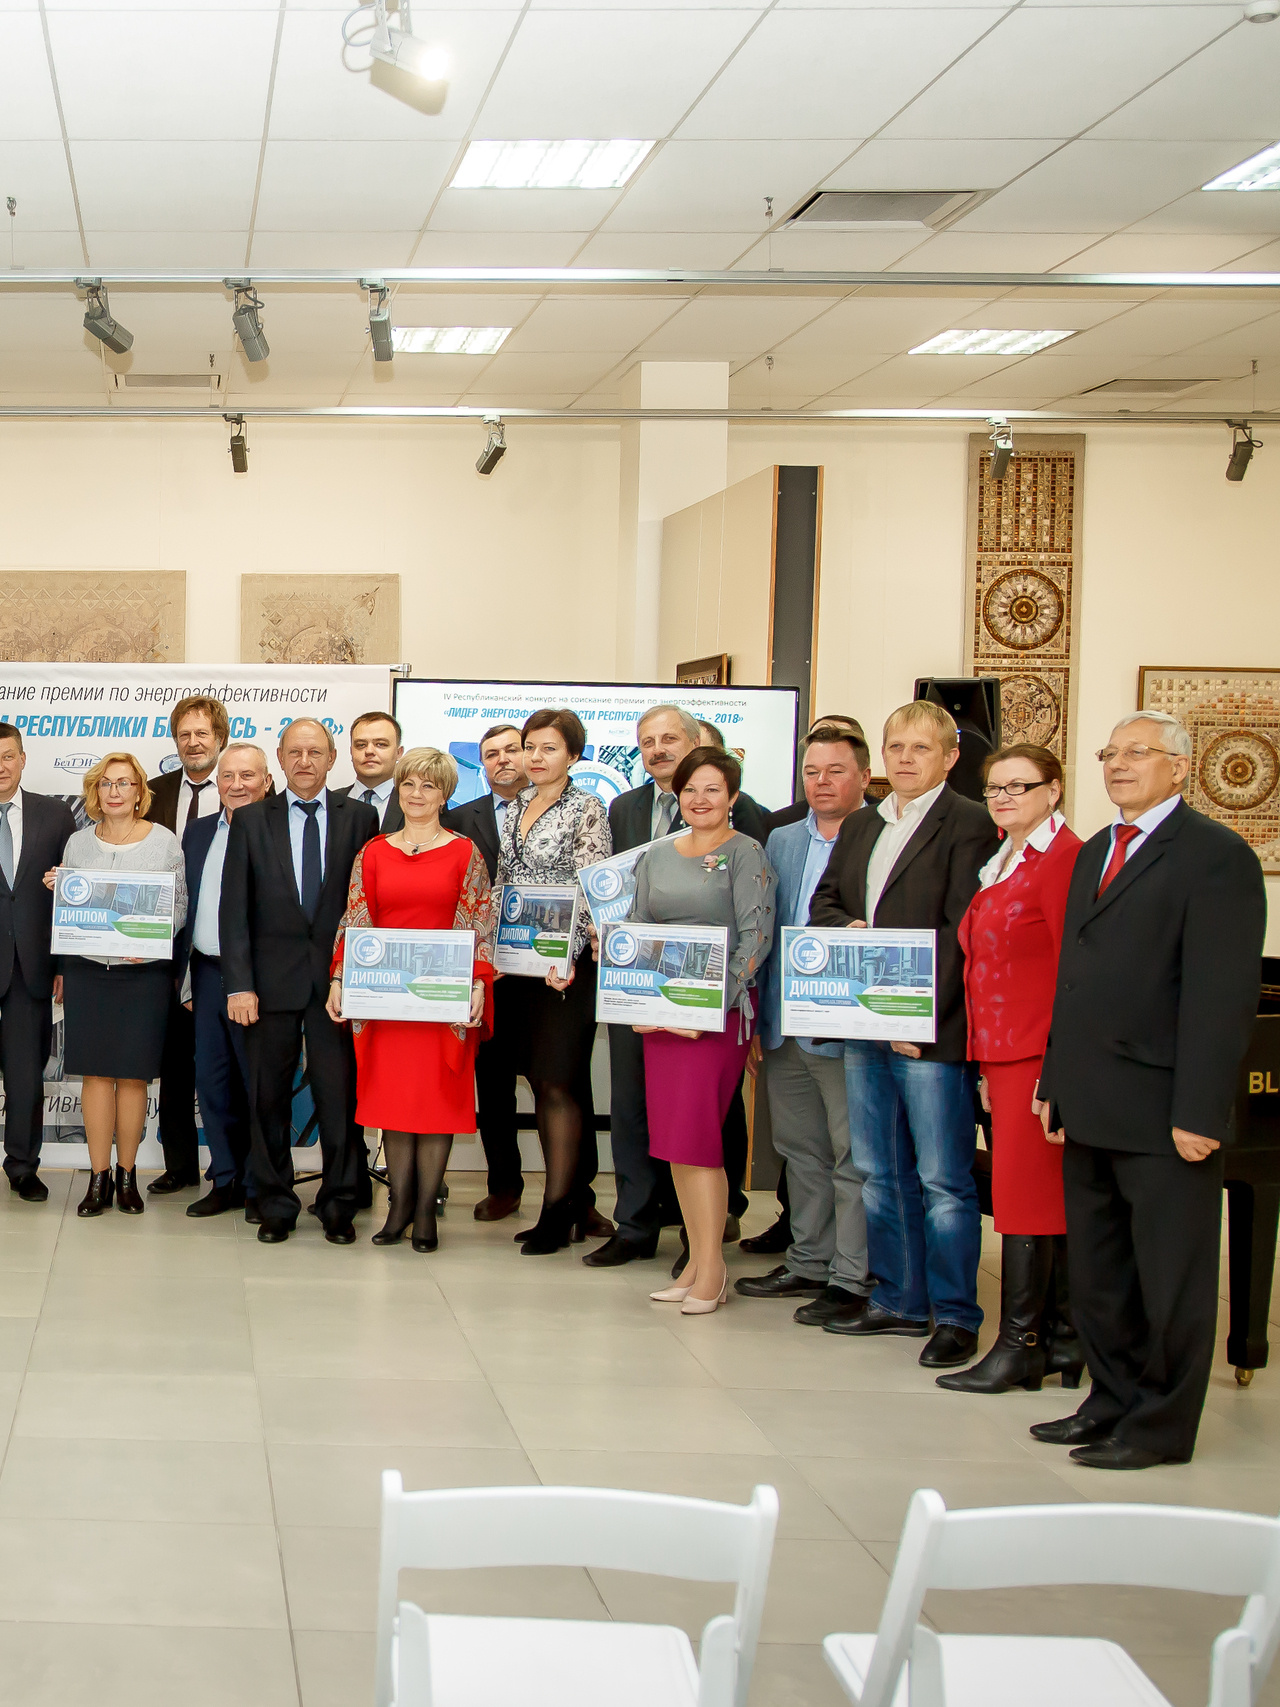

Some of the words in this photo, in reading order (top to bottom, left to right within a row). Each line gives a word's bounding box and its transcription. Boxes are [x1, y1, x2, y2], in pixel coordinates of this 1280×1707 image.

[40, 686, 104, 705] премии
[109, 687, 130, 702] по
[134, 684, 328, 706] энергоэффективности
[453, 693, 522, 702] Республиканский
[660, 699, 747, 707] энергоэффективности
[443, 707, 479, 718] «ЛИДЕР
[597, 710, 644, 721] РЕСПУБЛ
[714, 713, 744, 724] 2018»
[15, 715, 148, 737] РЕСПУБЛИКИ
[59, 909, 108, 923] ДИПЛОМ
[598, 895, 633, 923] ДИПЛ
[500, 927, 530, 941] ДИПЛОМ
[349, 971, 401, 986] ДИПЛОМ
[604, 970, 654, 988] ДИПЛОМ
[789, 980, 850, 998] ДИПЛОМ
